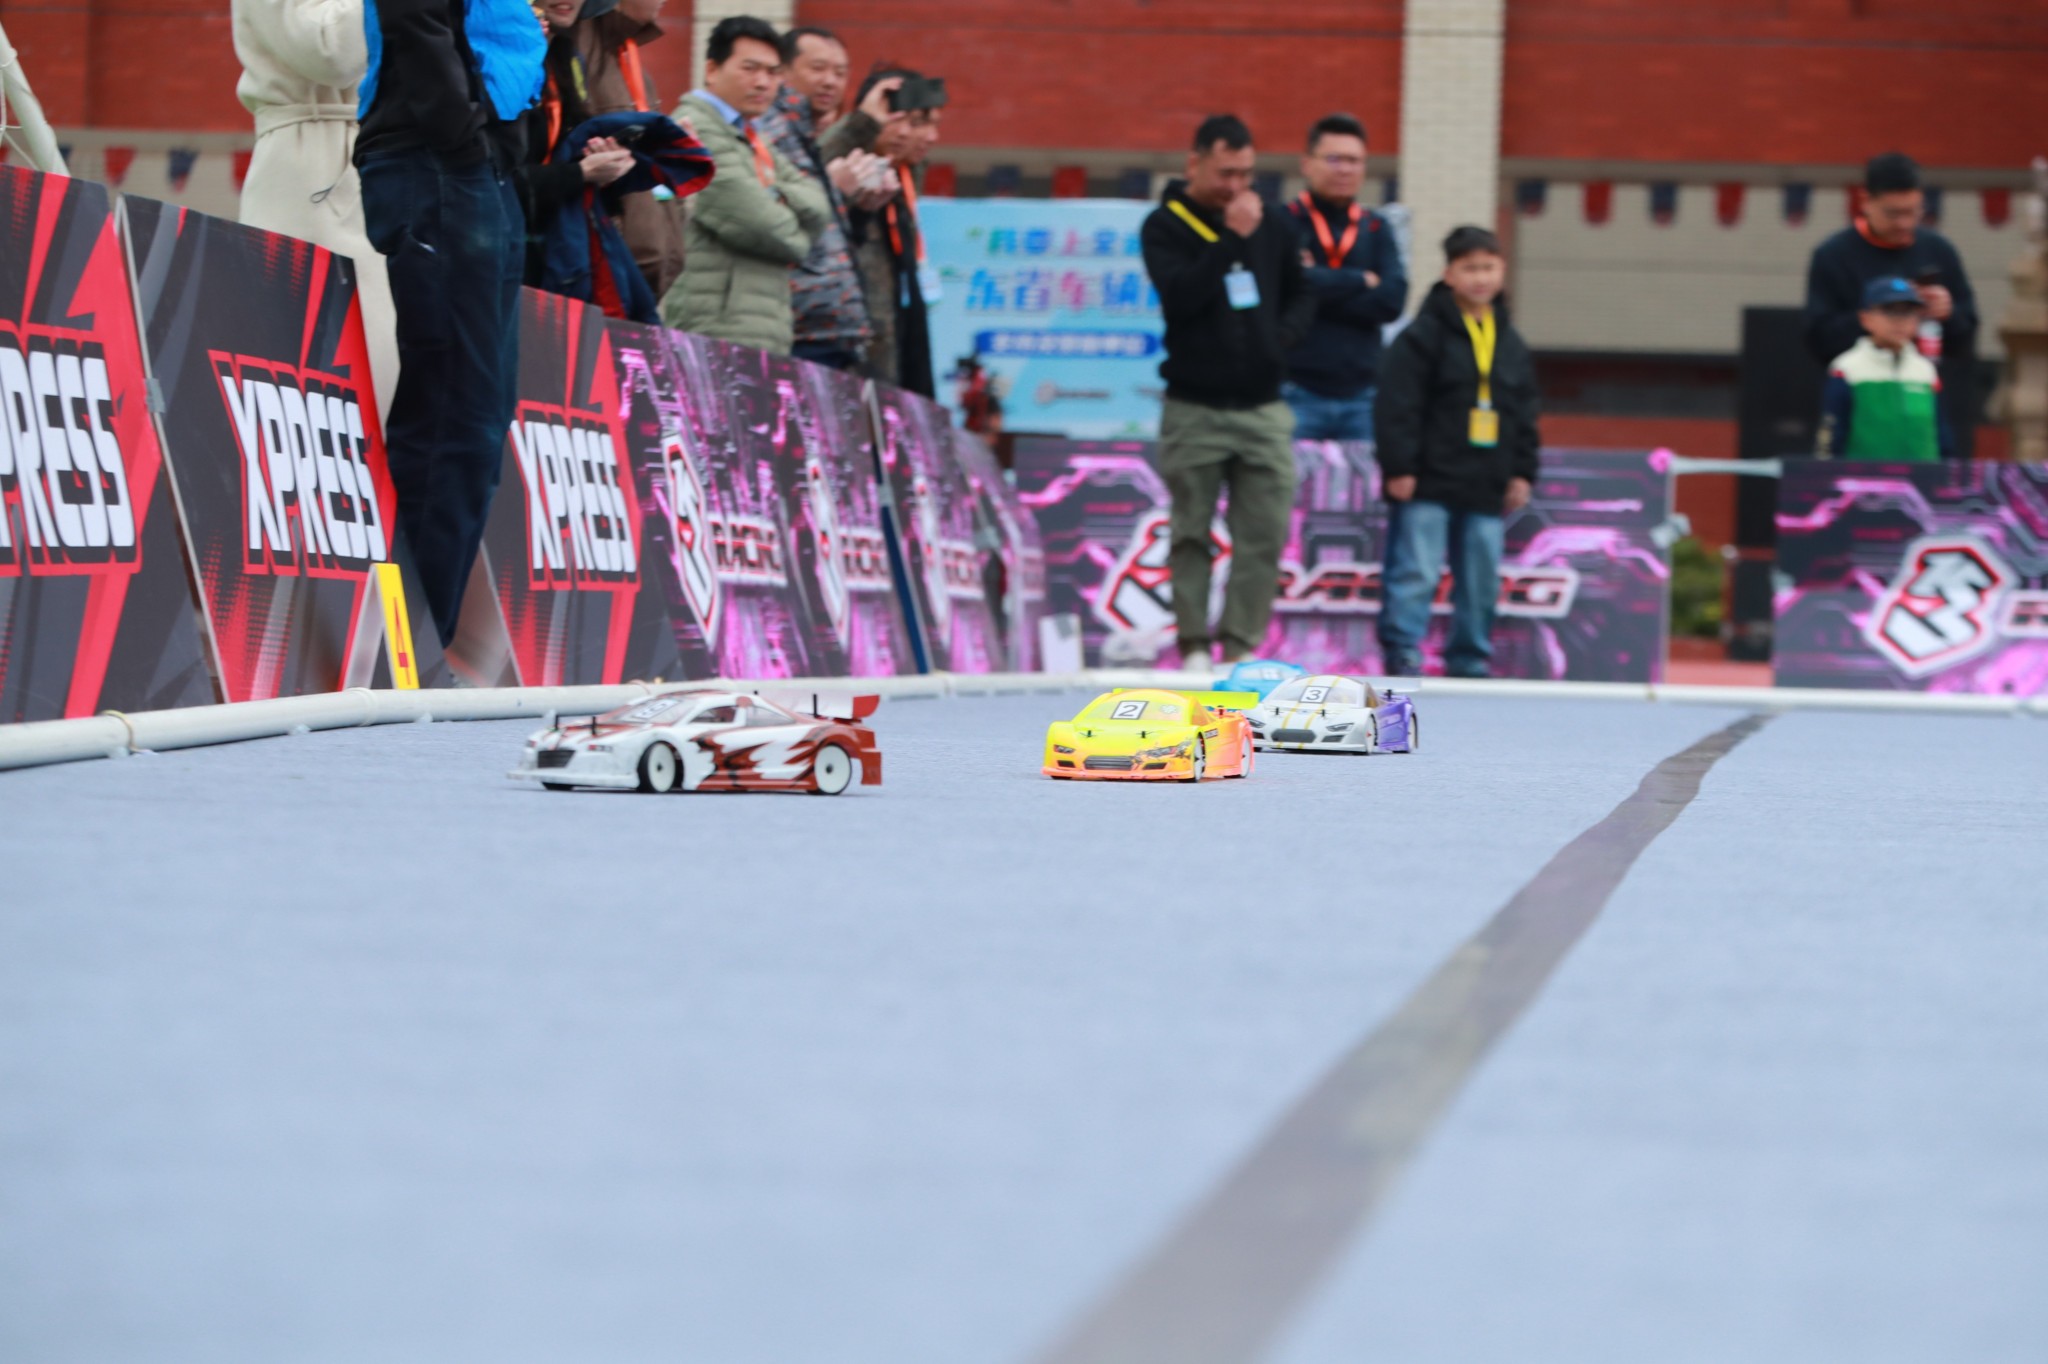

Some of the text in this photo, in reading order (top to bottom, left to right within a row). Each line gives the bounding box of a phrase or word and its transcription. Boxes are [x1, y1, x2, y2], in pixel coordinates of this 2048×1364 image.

[221, 375, 387, 562] XPRESS
[510, 419, 638, 573] XPRESS
[1117, 704, 1139, 717] 2
[1305, 689, 1322, 701] 3
